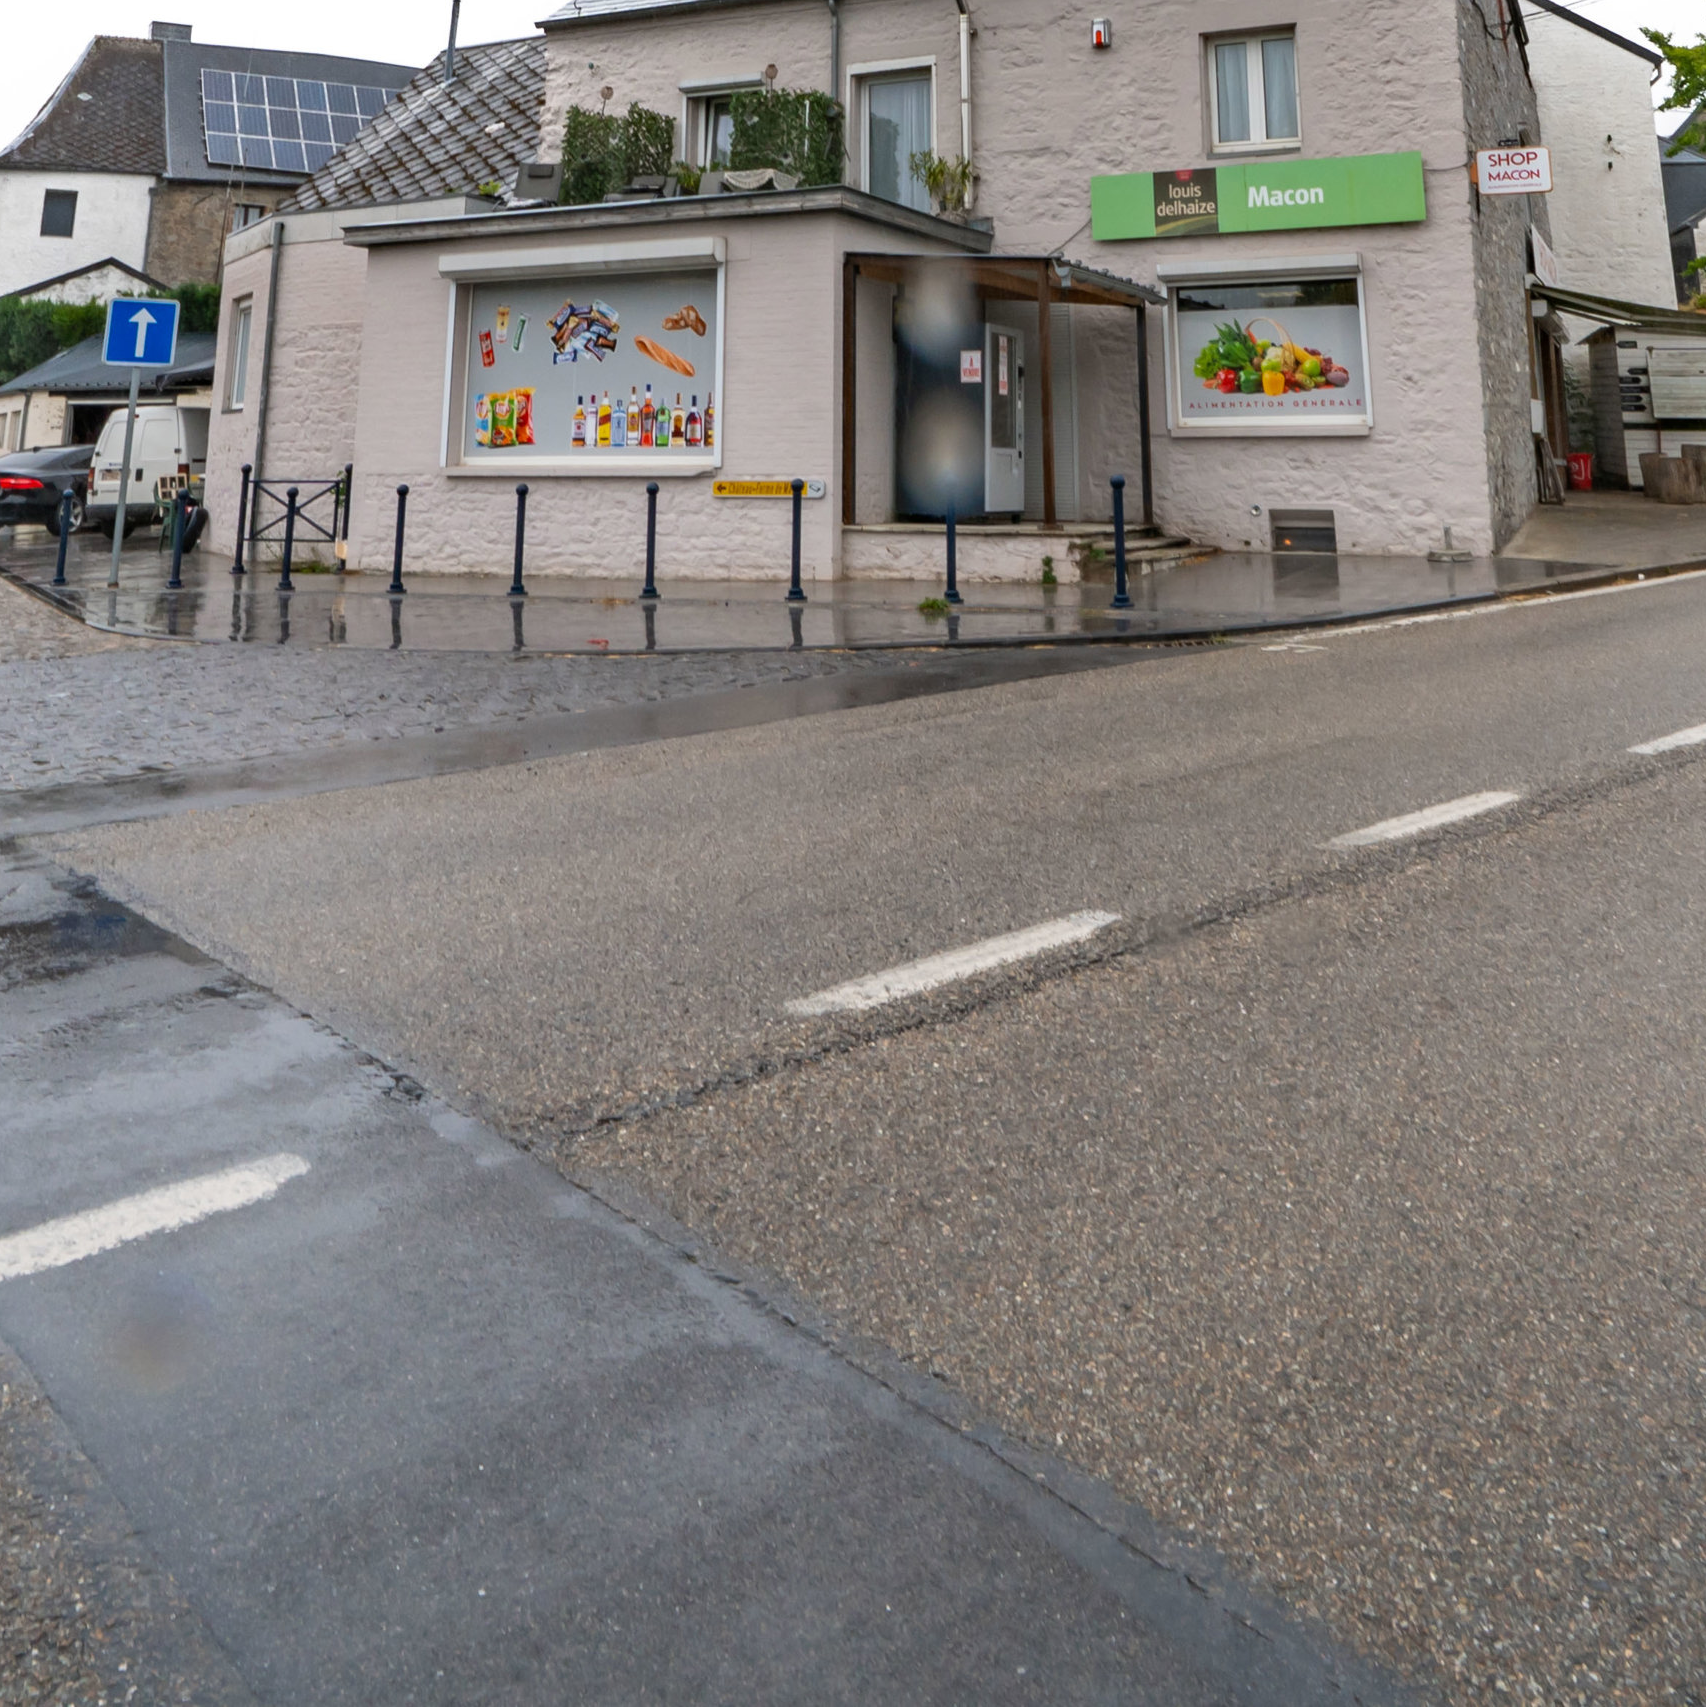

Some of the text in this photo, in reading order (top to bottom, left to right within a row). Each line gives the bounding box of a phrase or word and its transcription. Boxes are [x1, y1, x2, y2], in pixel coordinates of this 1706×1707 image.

[1488, 152, 1538, 167] SHOP
[1488, 169, 1540, 181] MACON
[1168, 183, 1202, 198] louis
[1248, 186, 1324, 208] Macon
[1156, 199, 1216, 216] delhaize
[1189, 401, 1284, 409] ALIMENTATION
